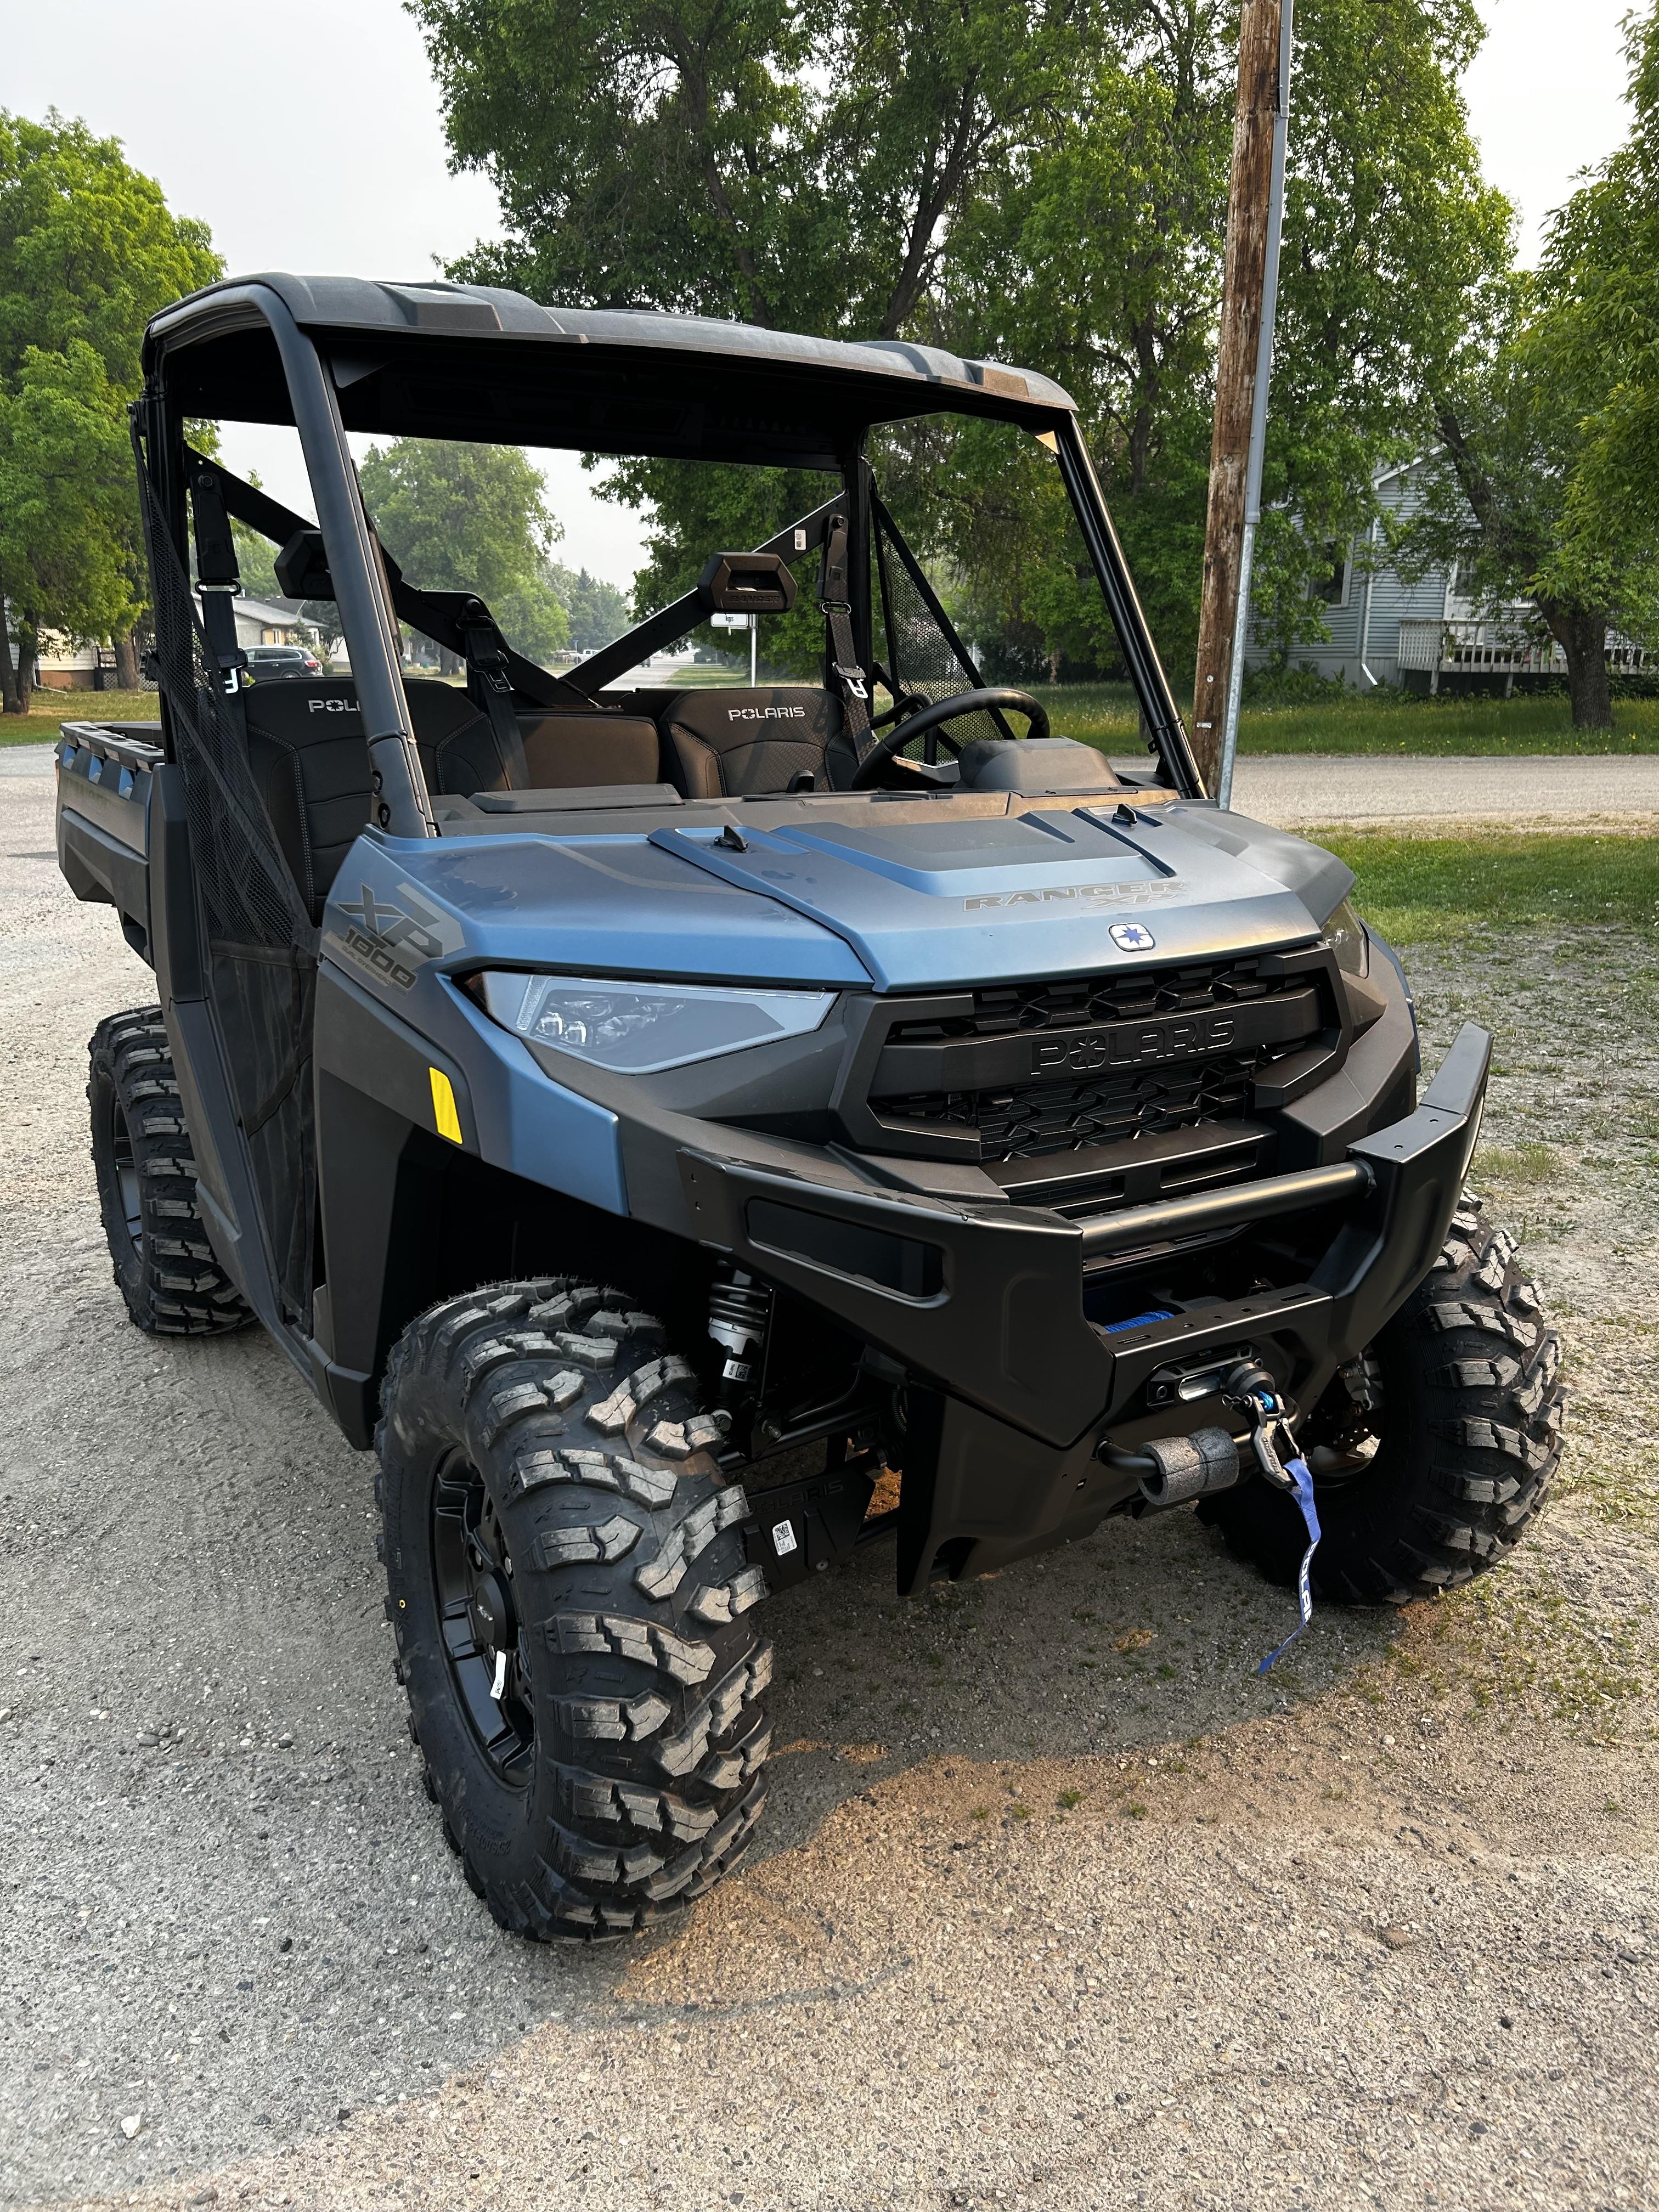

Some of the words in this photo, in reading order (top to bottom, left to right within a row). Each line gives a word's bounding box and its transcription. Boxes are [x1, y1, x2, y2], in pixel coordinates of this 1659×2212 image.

[308, 699, 361, 713] POL
[728, 707, 805, 721] POLARIS
[963, 881, 1186, 911] RANGER
[1081, 894, 1177, 910] XP
[331, 881, 444, 959] XP
[1030, 1014, 1235, 1075] POLARIS
